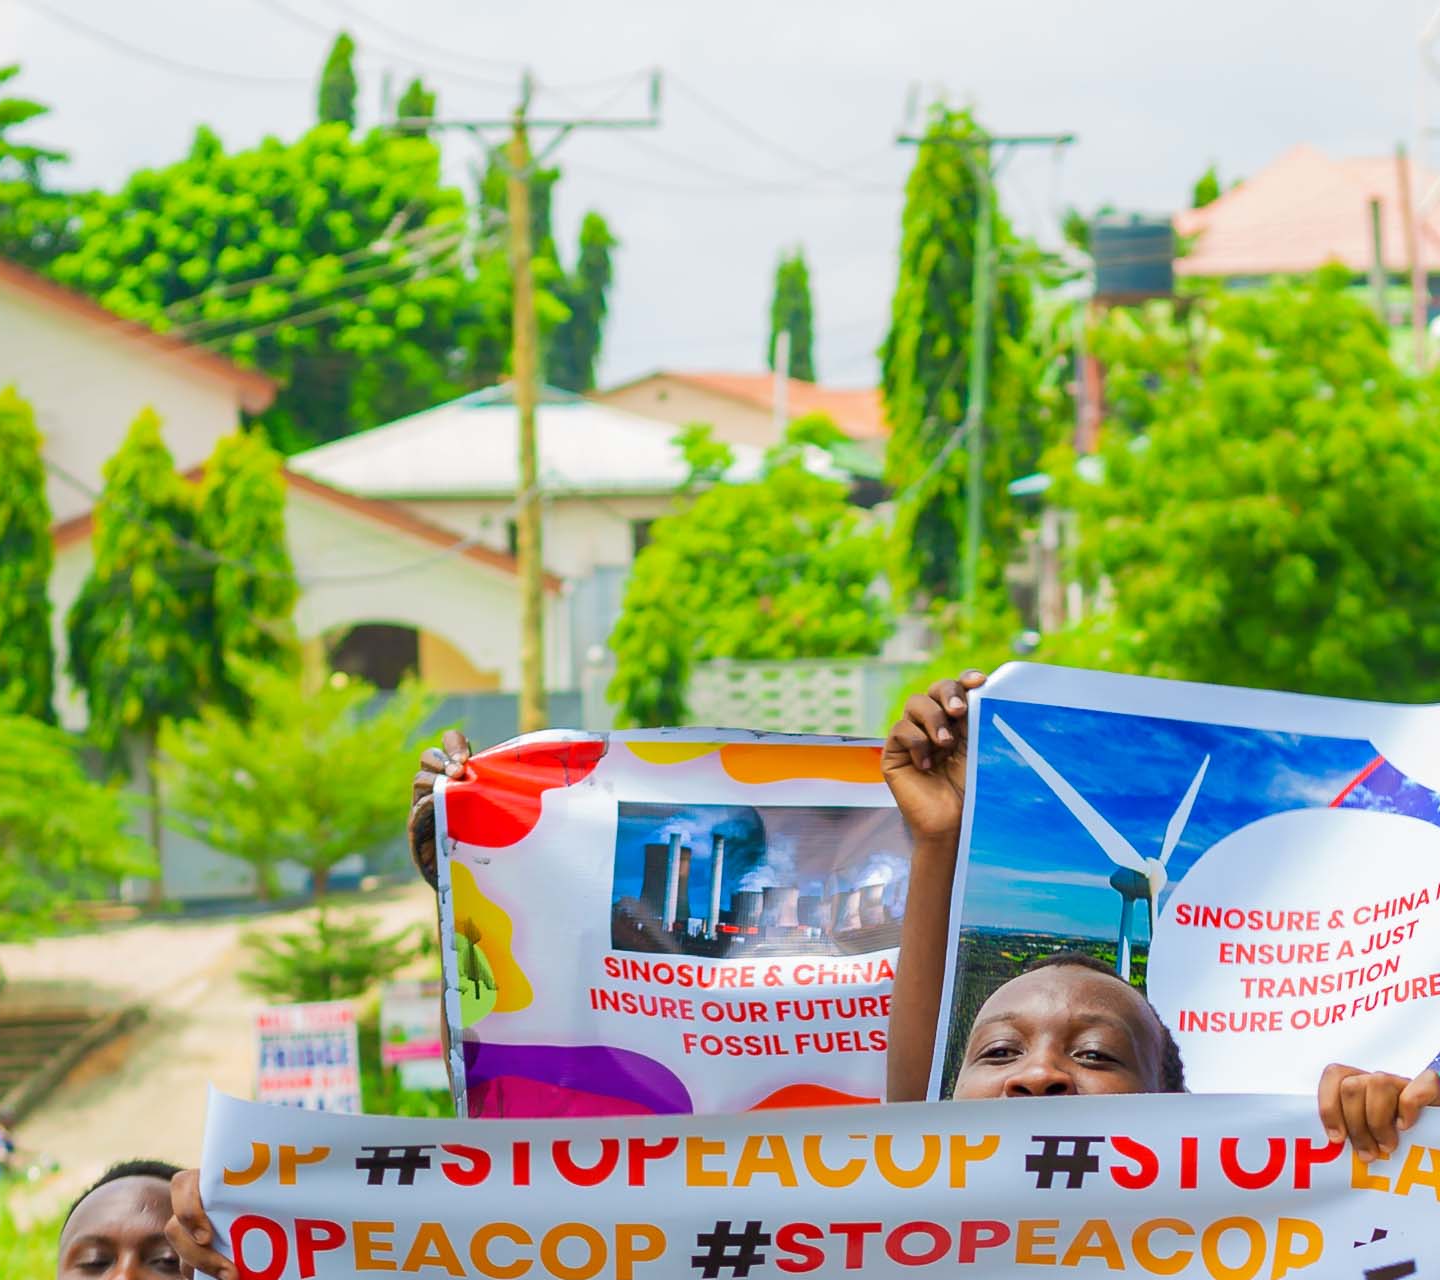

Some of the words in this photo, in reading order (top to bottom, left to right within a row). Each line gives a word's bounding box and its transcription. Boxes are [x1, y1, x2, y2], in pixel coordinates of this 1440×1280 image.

[1175, 903, 1320, 931] SINOSURE
[1327, 910, 1346, 929] &
[1353, 887, 1432, 925] CHINA
[1218, 942, 1330, 965] ENSURE
[1335, 940, 1355, 961] A
[1360, 919, 1420, 955] JUST
[603, 957, 756, 988] SINOSURE
[763, 965, 784, 987] &
[793, 958, 897, 986] CHINA
[1240, 955, 1401, 1000] TRANSITION
[588, 988, 695, 1021] INSURE
[701, 1000, 769, 1023] OUR
[1178, 1009, 1283, 1033] INSURE
[1290, 1004, 1347, 1031] OUR
[683, 1032, 789, 1057] FOSSIL
[795, 1030, 888, 1054] FUELS
